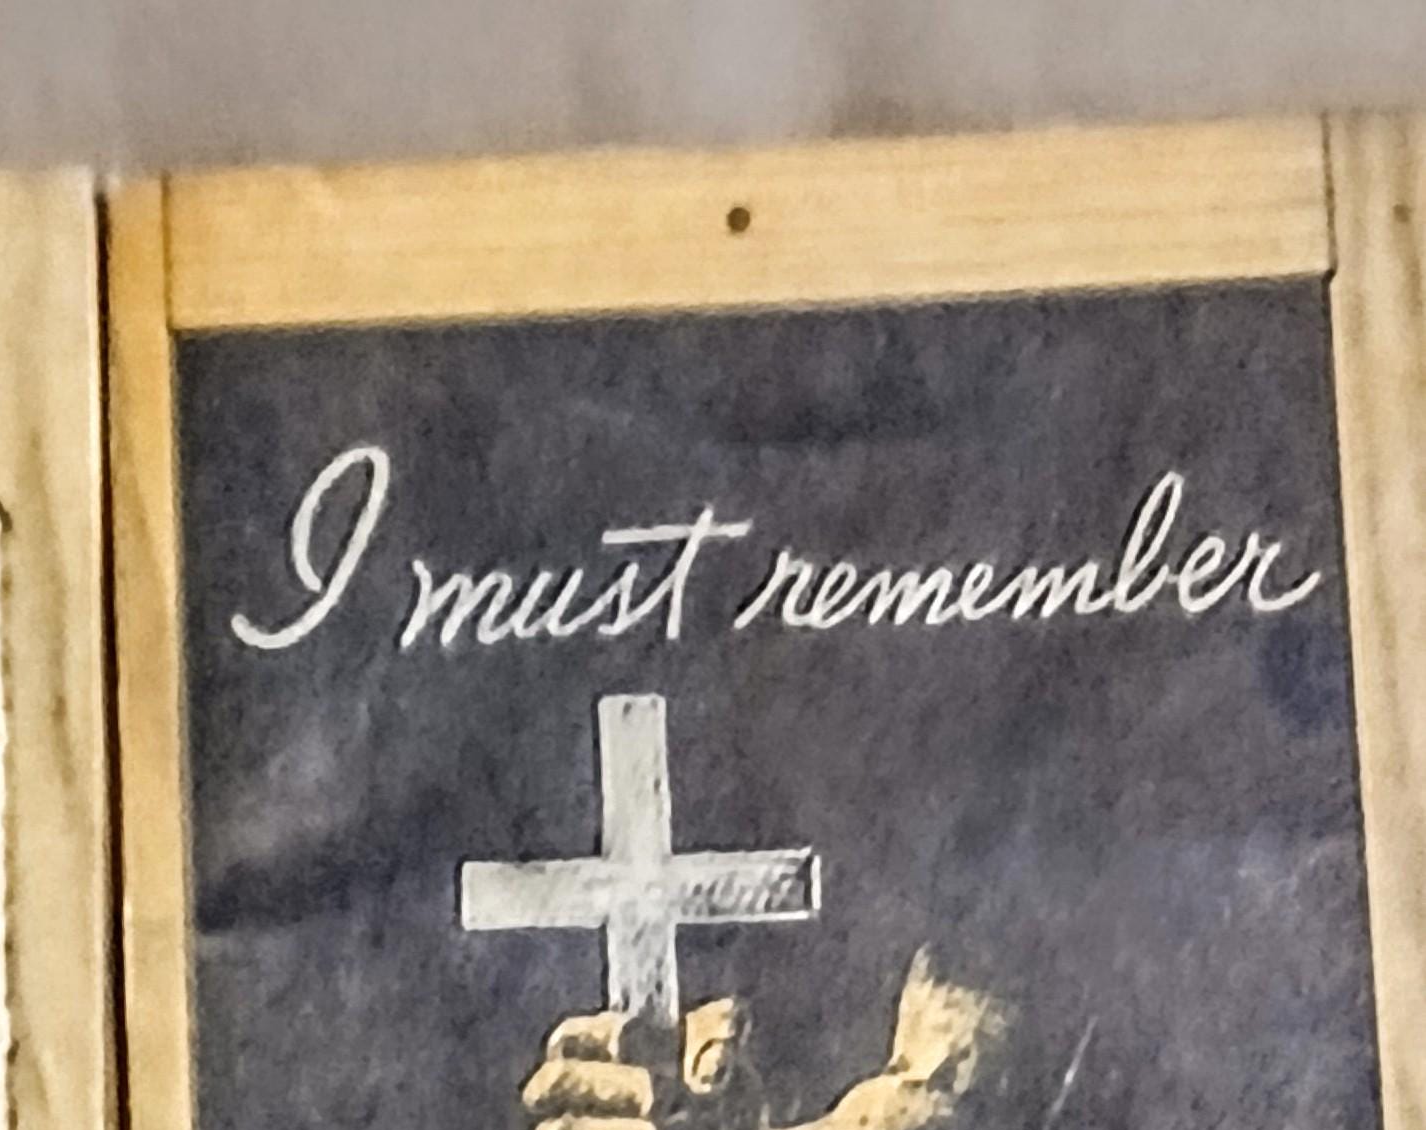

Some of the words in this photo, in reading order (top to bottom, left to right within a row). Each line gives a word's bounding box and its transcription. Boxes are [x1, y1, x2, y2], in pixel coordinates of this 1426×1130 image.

[231, 443, 390, 649] I
[401, 509, 750, 648] must
[734, 472, 1322, 630] remember
